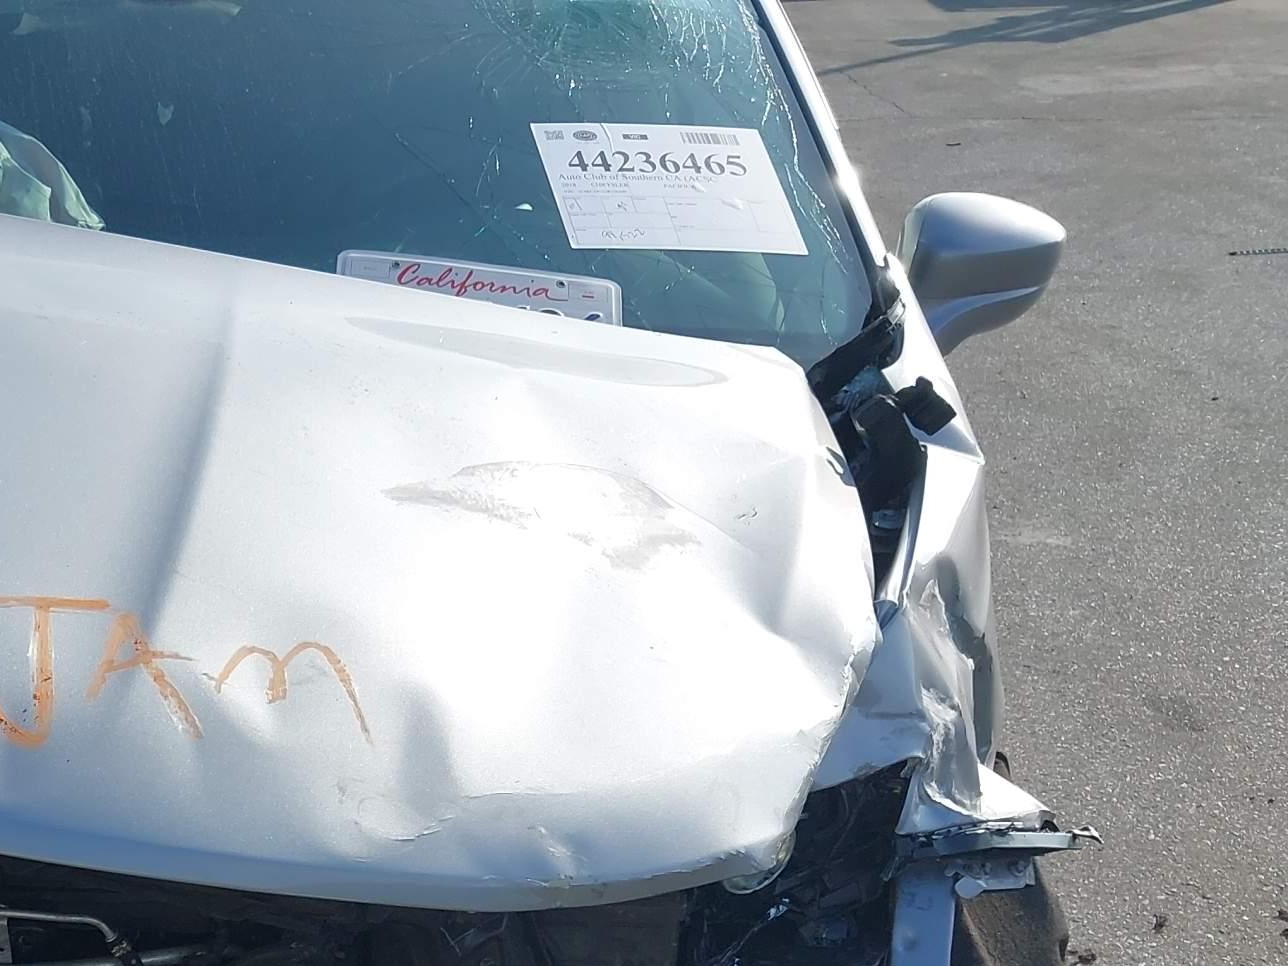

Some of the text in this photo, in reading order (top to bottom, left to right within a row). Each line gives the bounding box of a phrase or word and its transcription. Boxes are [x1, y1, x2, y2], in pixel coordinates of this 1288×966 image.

[568, 150, 748, 177] 44236465
[559, 173, 582, 181] Auto
[583, 173, 607, 181] Club
[608, 173, 619, 181] of
[621, 173, 663, 182] Southern
[397, 263, 569, 302] California
